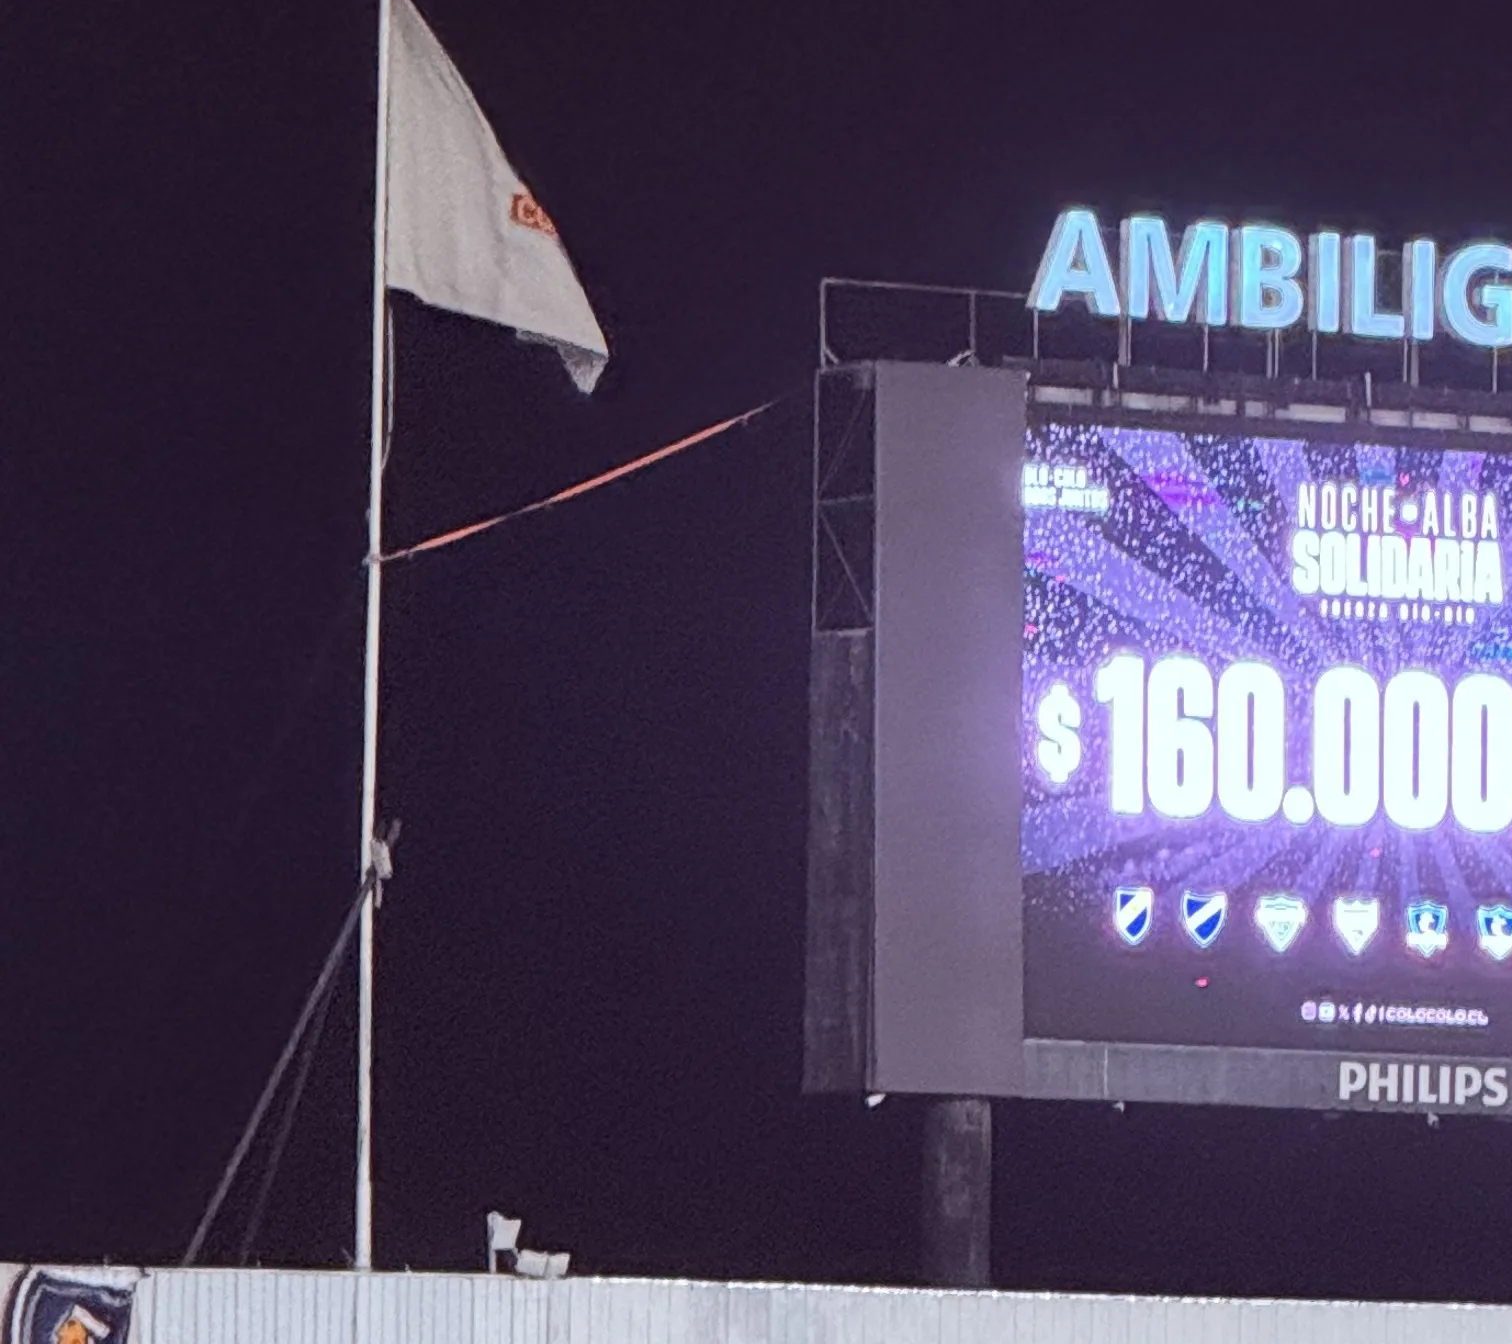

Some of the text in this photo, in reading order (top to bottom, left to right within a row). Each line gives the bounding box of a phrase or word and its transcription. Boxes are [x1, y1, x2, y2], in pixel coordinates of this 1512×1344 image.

[1298, 481, 1498, 539] NOCHE ALBA
[1292, 529, 1504, 604] SOLIDARIA
[1339, 1061, 1509, 1106] PHILIPS
